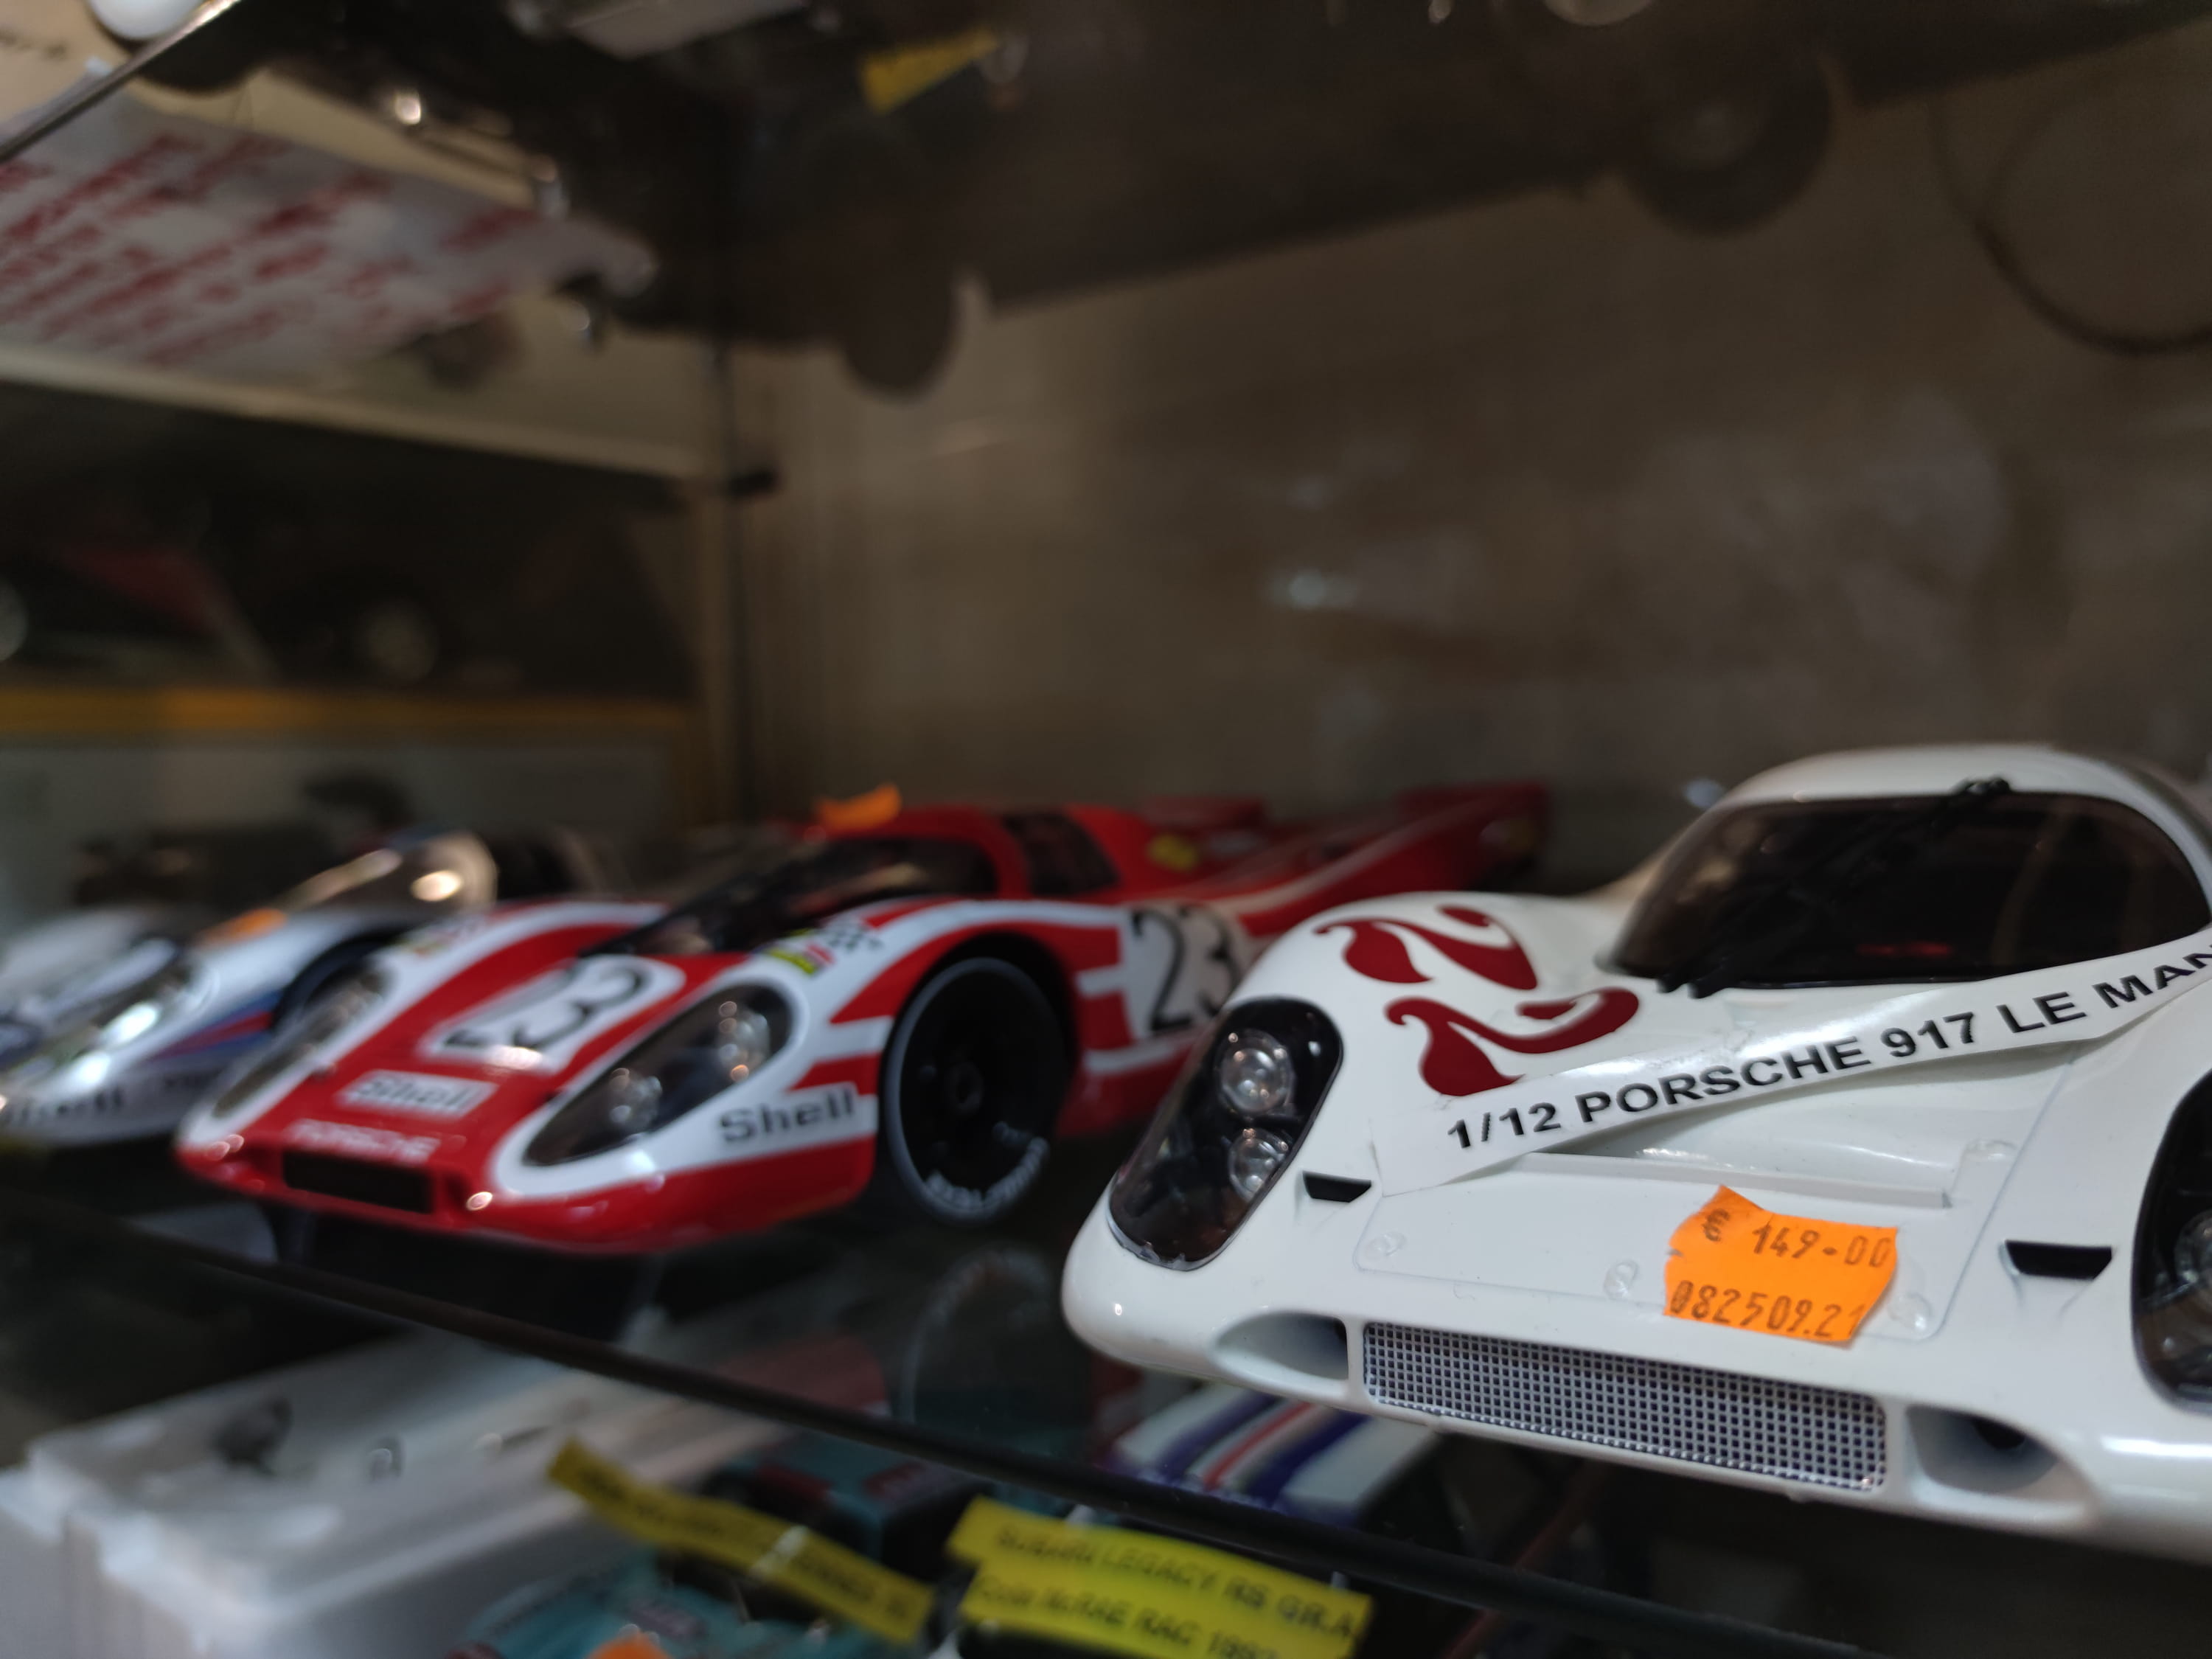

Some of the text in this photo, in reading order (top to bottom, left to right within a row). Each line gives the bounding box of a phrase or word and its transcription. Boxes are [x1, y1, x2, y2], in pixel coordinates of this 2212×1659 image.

[1131, 905, 1242, 1032] 23
[718, 1087, 855, 1142] Shell
[1447, 1102, 1561, 1150] 1/12
[1574, 1036, 1871, 1124] PORSCHE
[1880, 1010, 1976, 1058] 917
[1996, 991, 2088, 1034] LE
[1702, 1208, 1892, 1268] € 149-00
